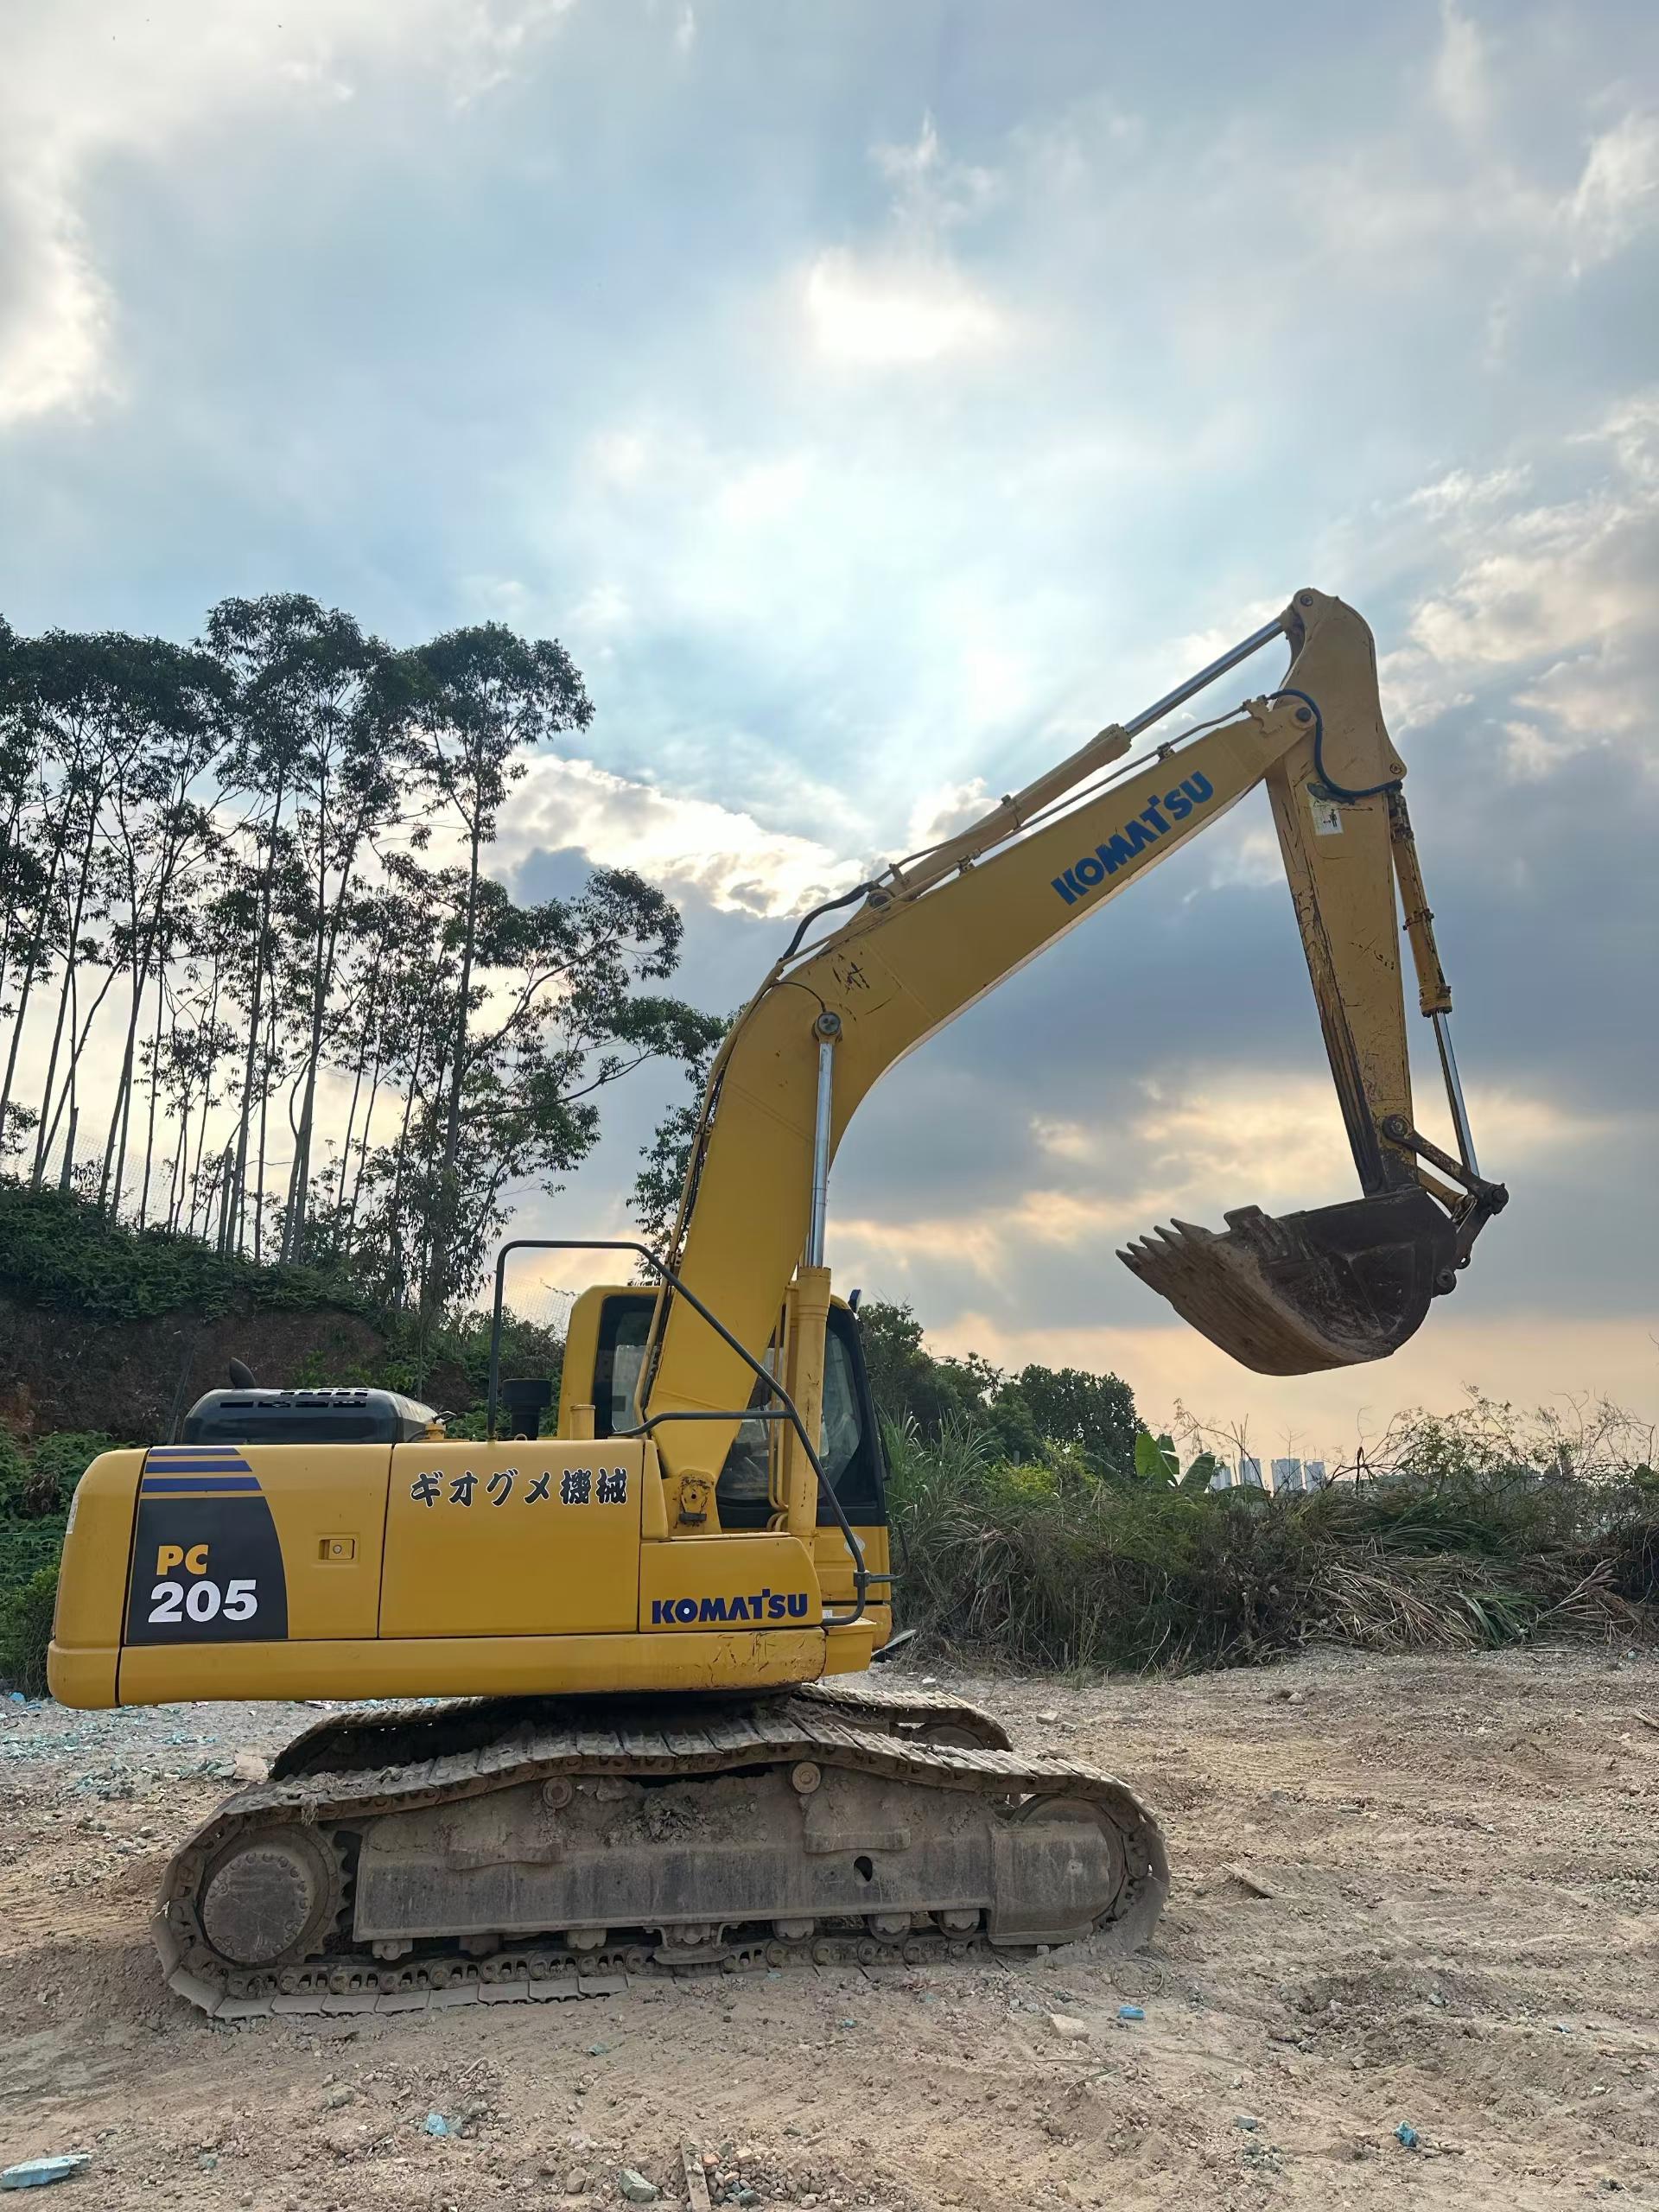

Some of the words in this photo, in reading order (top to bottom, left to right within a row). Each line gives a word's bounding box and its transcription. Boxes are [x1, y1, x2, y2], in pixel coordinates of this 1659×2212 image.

[1051, 771, 1213, 906] KOMATSU
[156, 1544, 209, 1575] PC
[148, 1580, 257, 1623] 205
[652, 1588, 808, 1624] KOMATSU
